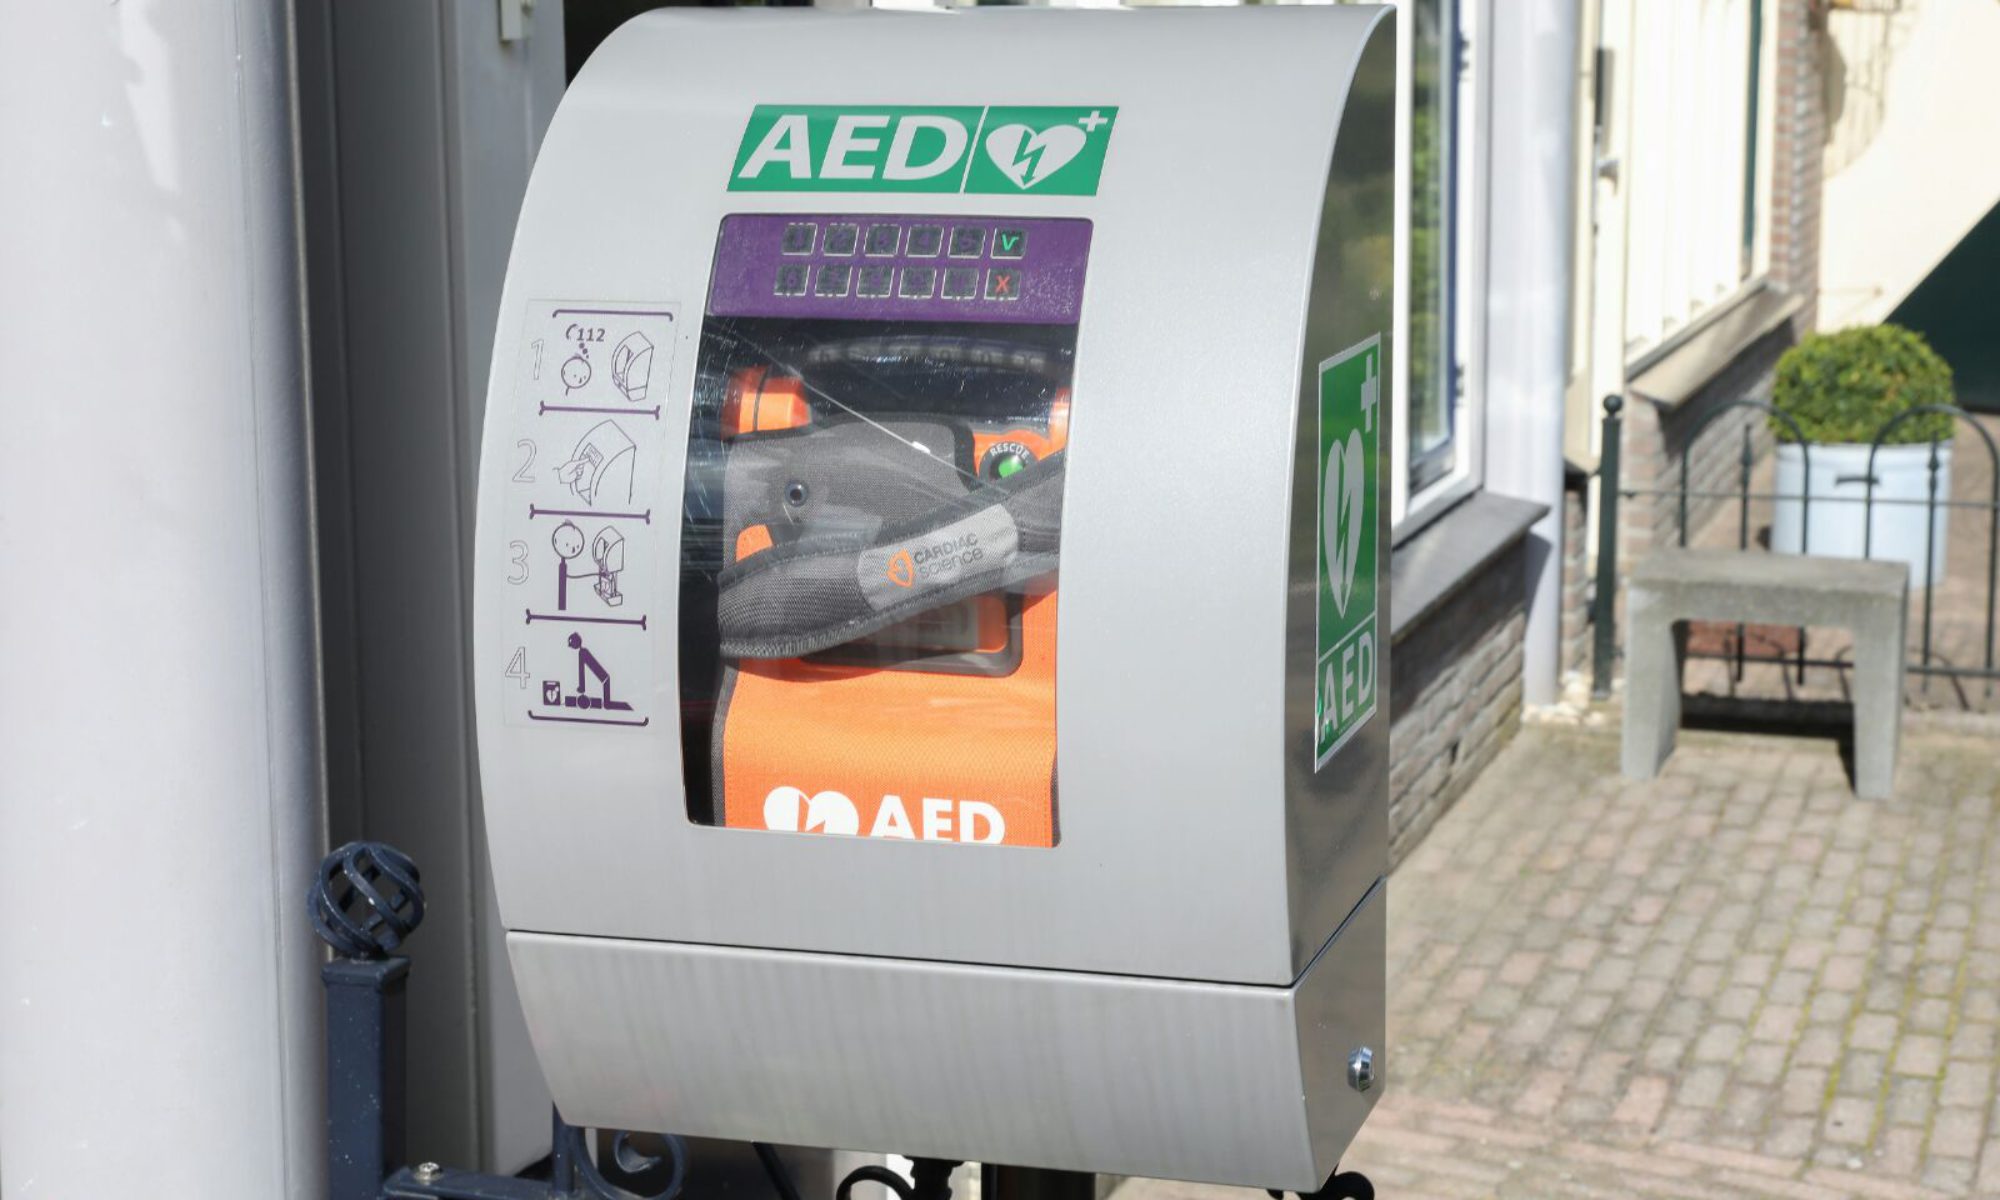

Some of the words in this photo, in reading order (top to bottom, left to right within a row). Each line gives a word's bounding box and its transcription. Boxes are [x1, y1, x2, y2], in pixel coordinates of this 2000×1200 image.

[738, 114, 968, 180] AED
[576, 327, 606, 342] 112
[531, 338, 544, 380] 1
[512, 438, 537, 483] 2
[990, 442, 1030, 460] RESCUE
[507, 539, 529, 585] 3
[913, 532, 979, 565] CARDIAC
[504, 646, 531, 690] 4
[1320, 631, 1374, 744] AED
[870, 794, 1006, 845] AED
